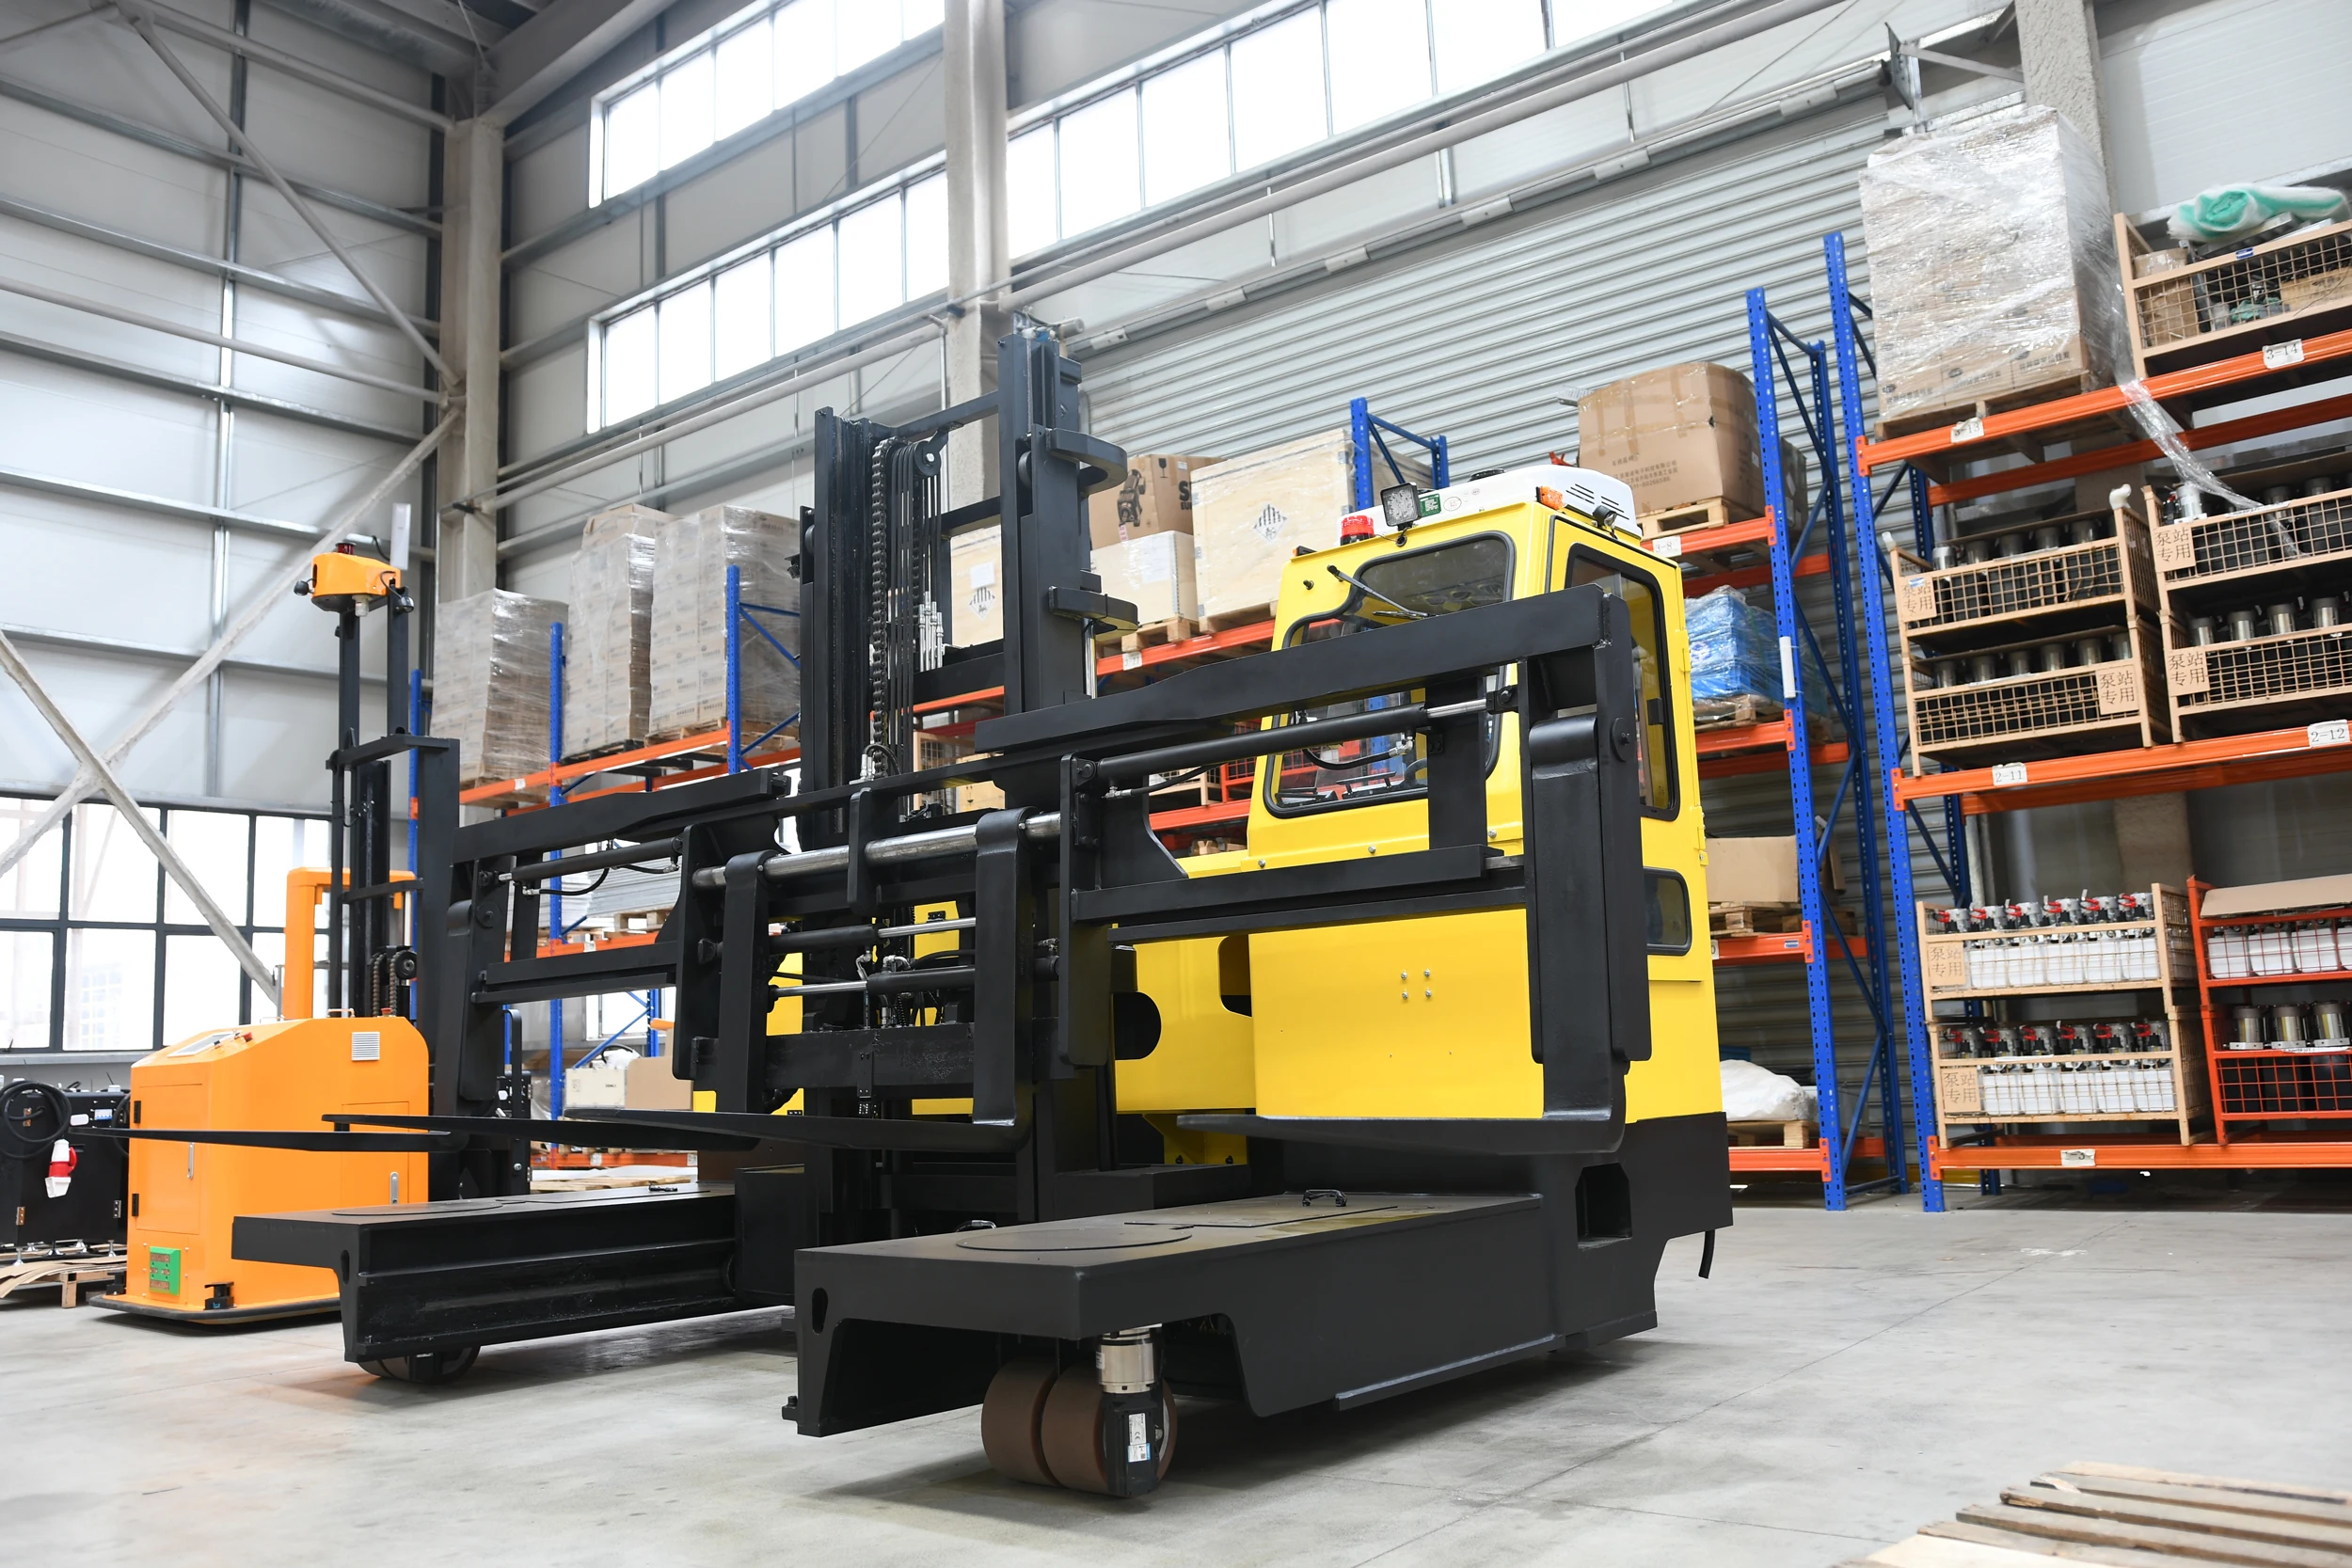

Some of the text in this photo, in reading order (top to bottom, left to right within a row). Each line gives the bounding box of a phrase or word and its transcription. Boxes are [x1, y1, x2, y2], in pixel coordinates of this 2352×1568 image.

[2266, 343, 2298, 359] 3-14
[1178, 480, 1191, 502] S
[2154, 527, 2189, 546] 泵站
[1655, 542, 1673, 553] 3-8
[2156, 543, 2191, 562] 专用
[1903, 595, 1933, 613] 专用
[2167, 651, 2203, 671] 泵站
[2099, 670, 2133, 689] 泵站
[2170, 667, 2205, 686] 专用
[2101, 687, 2135, 705] 专用
[2311, 727, 2345, 742] 2-12
[1994, 769, 2023, 783] 2-11
[1930, 944, 1962, 961] 泵站
[1931, 961, 1963, 977] 专用
[1943, 1070, 1977, 1087] 泵站
[1945, 1087, 1978, 1103] 专用
